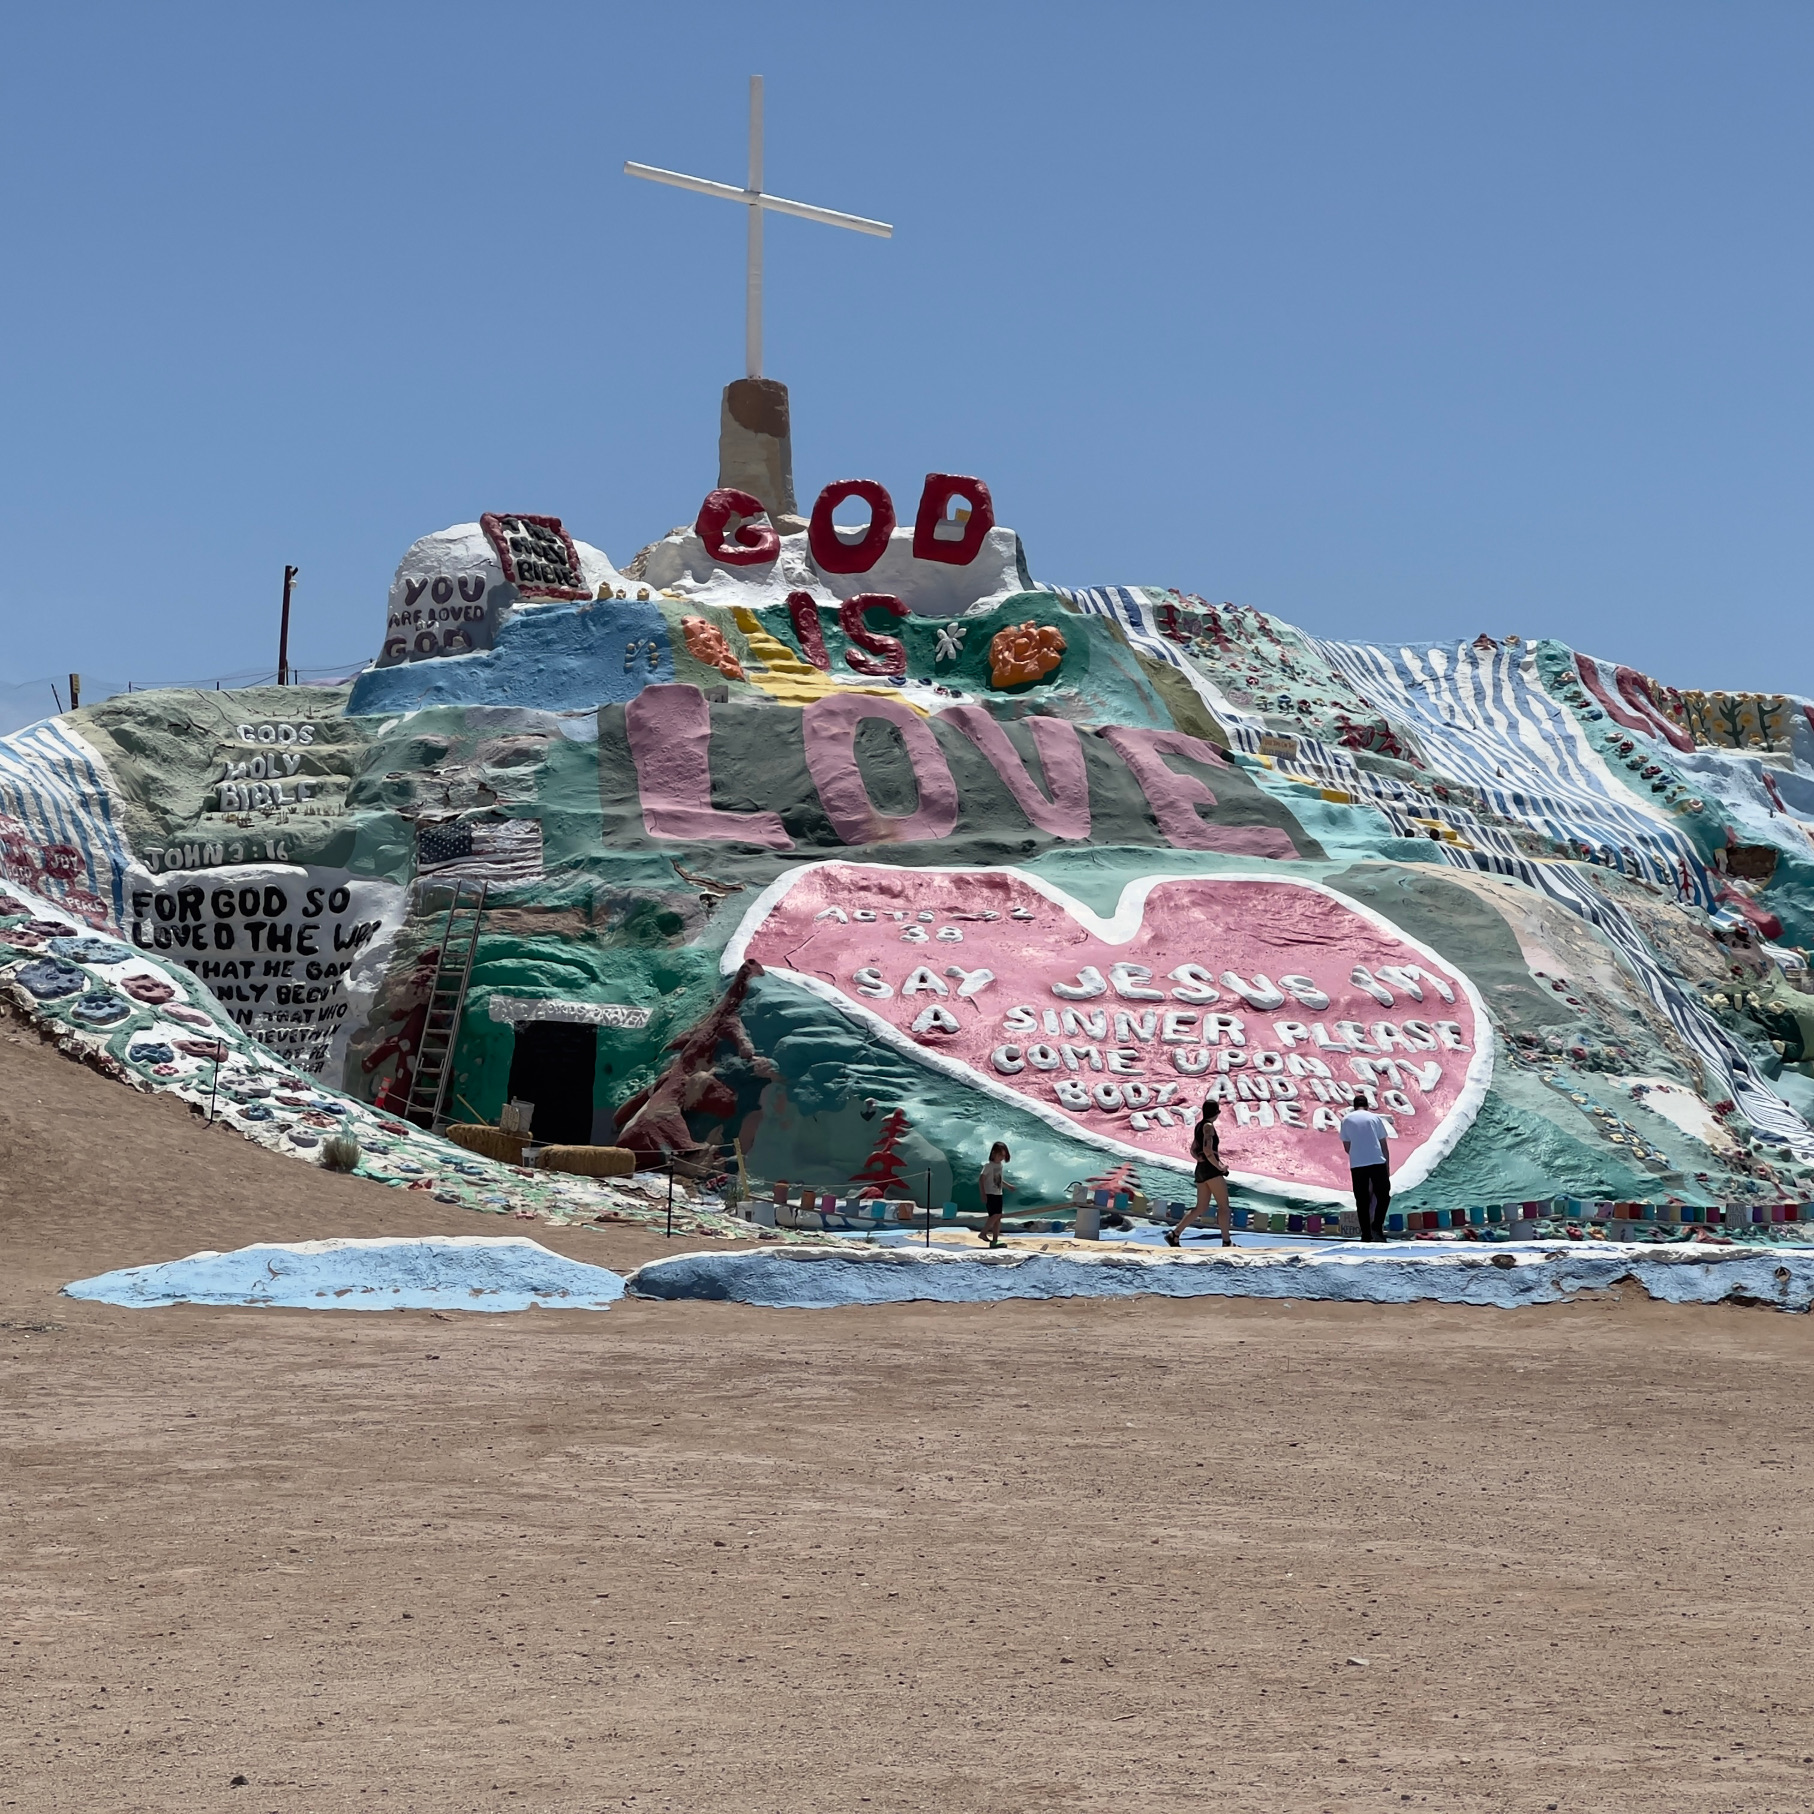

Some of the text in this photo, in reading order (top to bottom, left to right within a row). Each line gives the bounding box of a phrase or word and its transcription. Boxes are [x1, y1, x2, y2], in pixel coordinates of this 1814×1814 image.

[696, 473, 994, 574] GOD
[517, 559, 578, 587] BIBLE
[405, 576, 485, 606] YOU
[389, 606, 484, 628] ARE LOVED
[384, 629, 473, 658] GOD
[787, 591, 909, 677] IS
[237, 724, 315, 745] GODS
[224, 753, 300, 780] HOLY
[626, 684, 1301, 859] LOVE
[219, 780, 317, 811] BIBLE
[51, 853, 78, 872] JOY
[144, 844, 223, 873] JOHN
[66, 897, 104, 912] PEACE
[131, 884, 350, 922] FOR GOD SO
[814, 906, 934, 923] ACTS
[132, 922, 235, 950] LOVED
[244, 921, 321, 956] THE
[899, 924, 963, 943] 38
[184, 960, 352, 980] THAT HE GAV
[209, 983, 268, 1003] NLY
[853, 966, 995, 998] SAY
[1052, 962, 1330, 1010] JESUS
[226, 1003, 348, 1025] ON THAT WHO
[911, 1004, 1471, 1054] A SINNER PLEASE
[991, 1044, 1442, 1092] COME UPON MY
[1053, 1074, 1415, 1116] BODY AND INTO
[1130, 1101, 1398, 1139] MY HEAT
